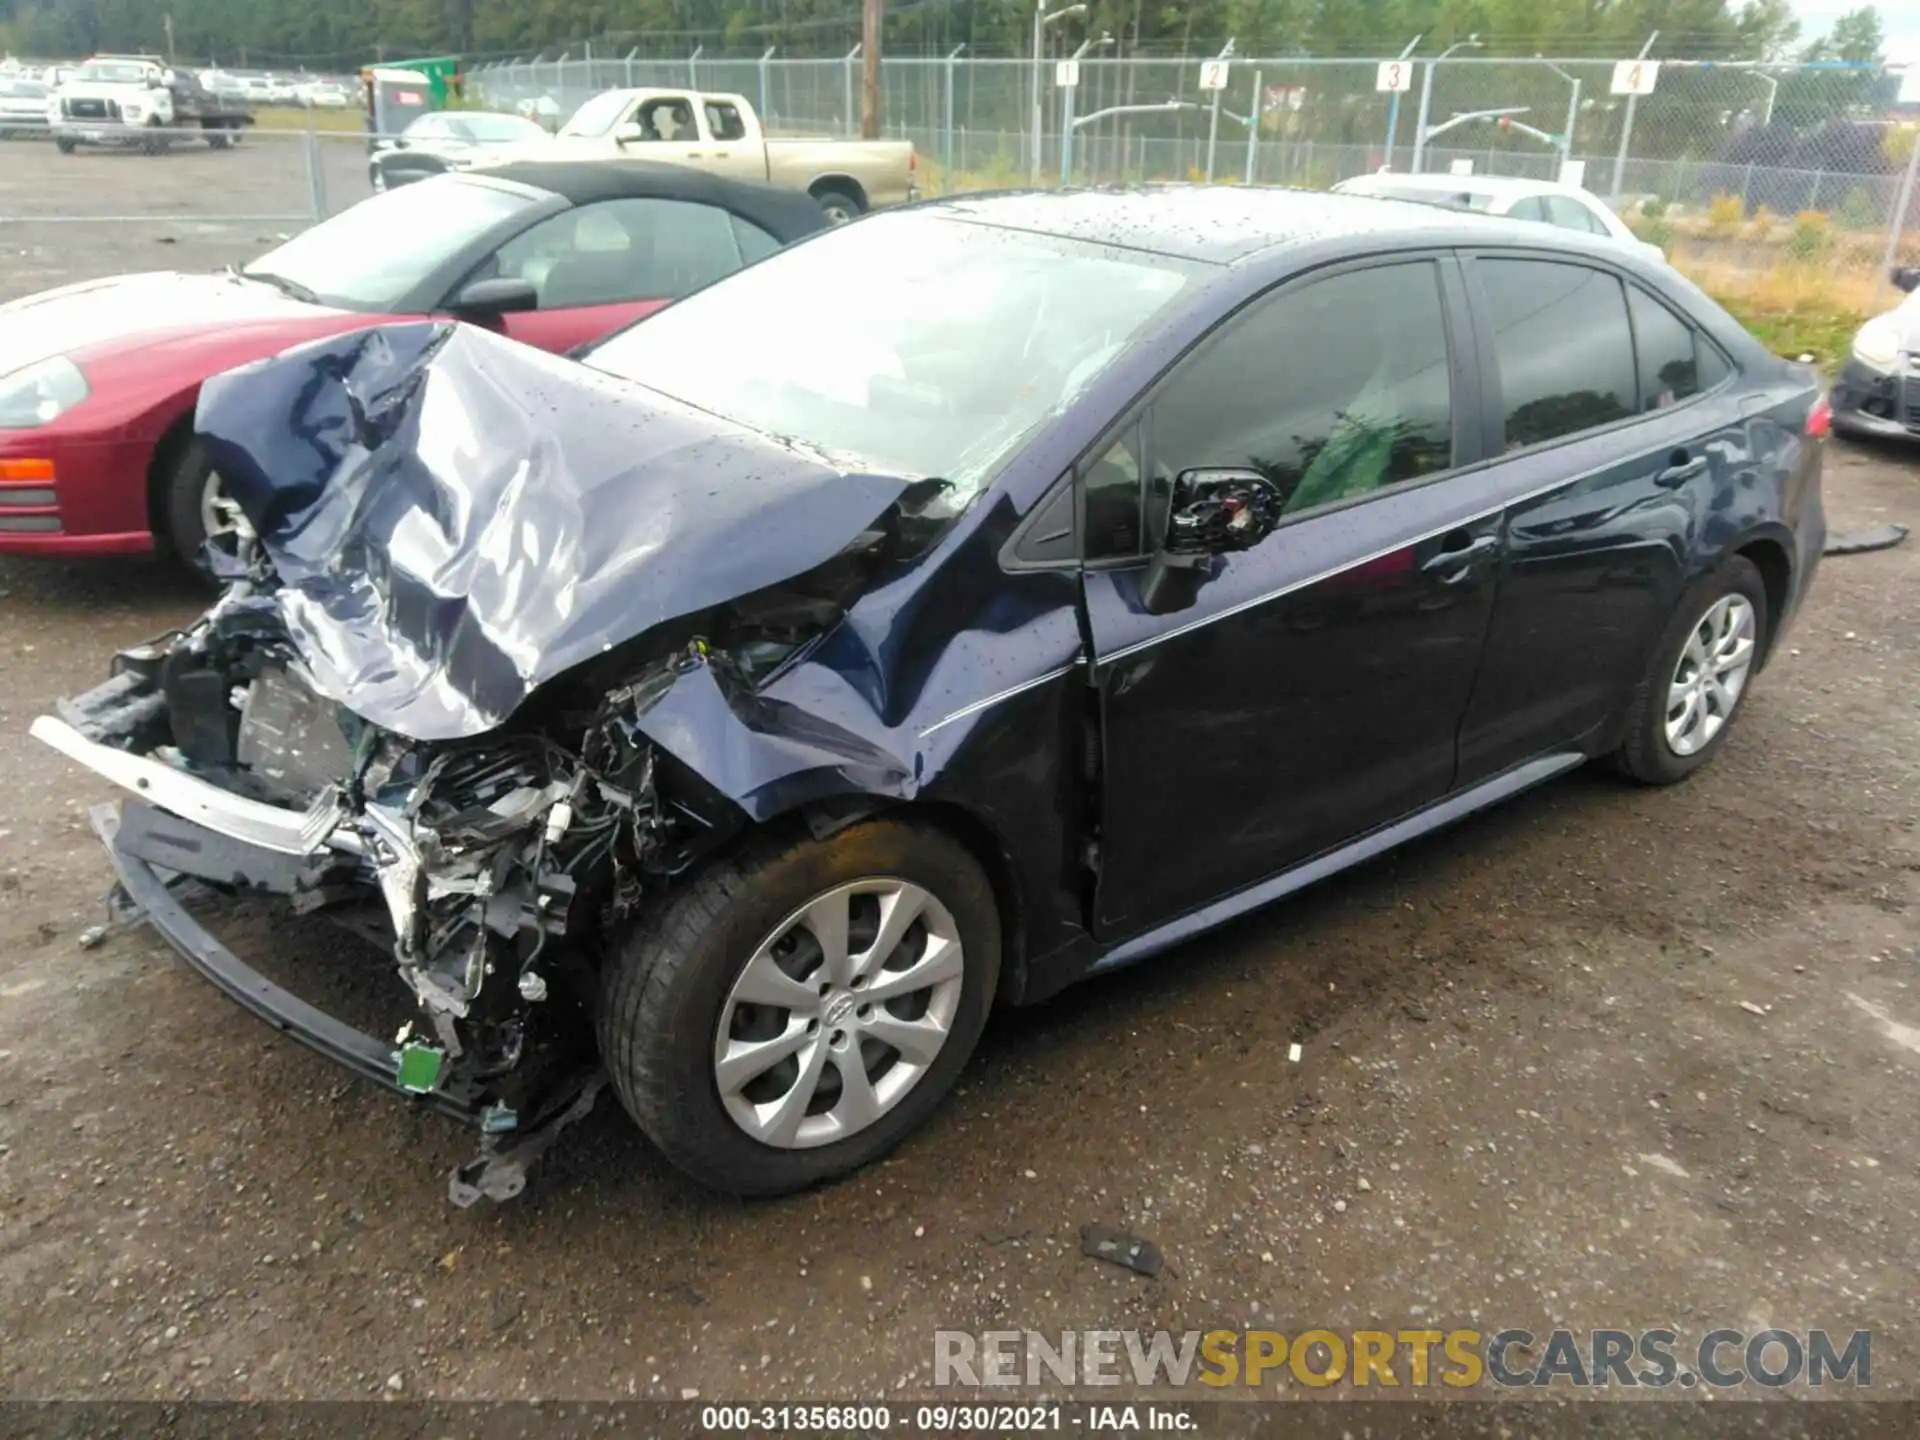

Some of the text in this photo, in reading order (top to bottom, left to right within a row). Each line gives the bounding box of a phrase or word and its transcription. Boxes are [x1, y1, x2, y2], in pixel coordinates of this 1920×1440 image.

[1208, 63, 1219, 86] 2
[1388, 64, 1401, 88] 3
[1627, 64, 1642, 90] 4
